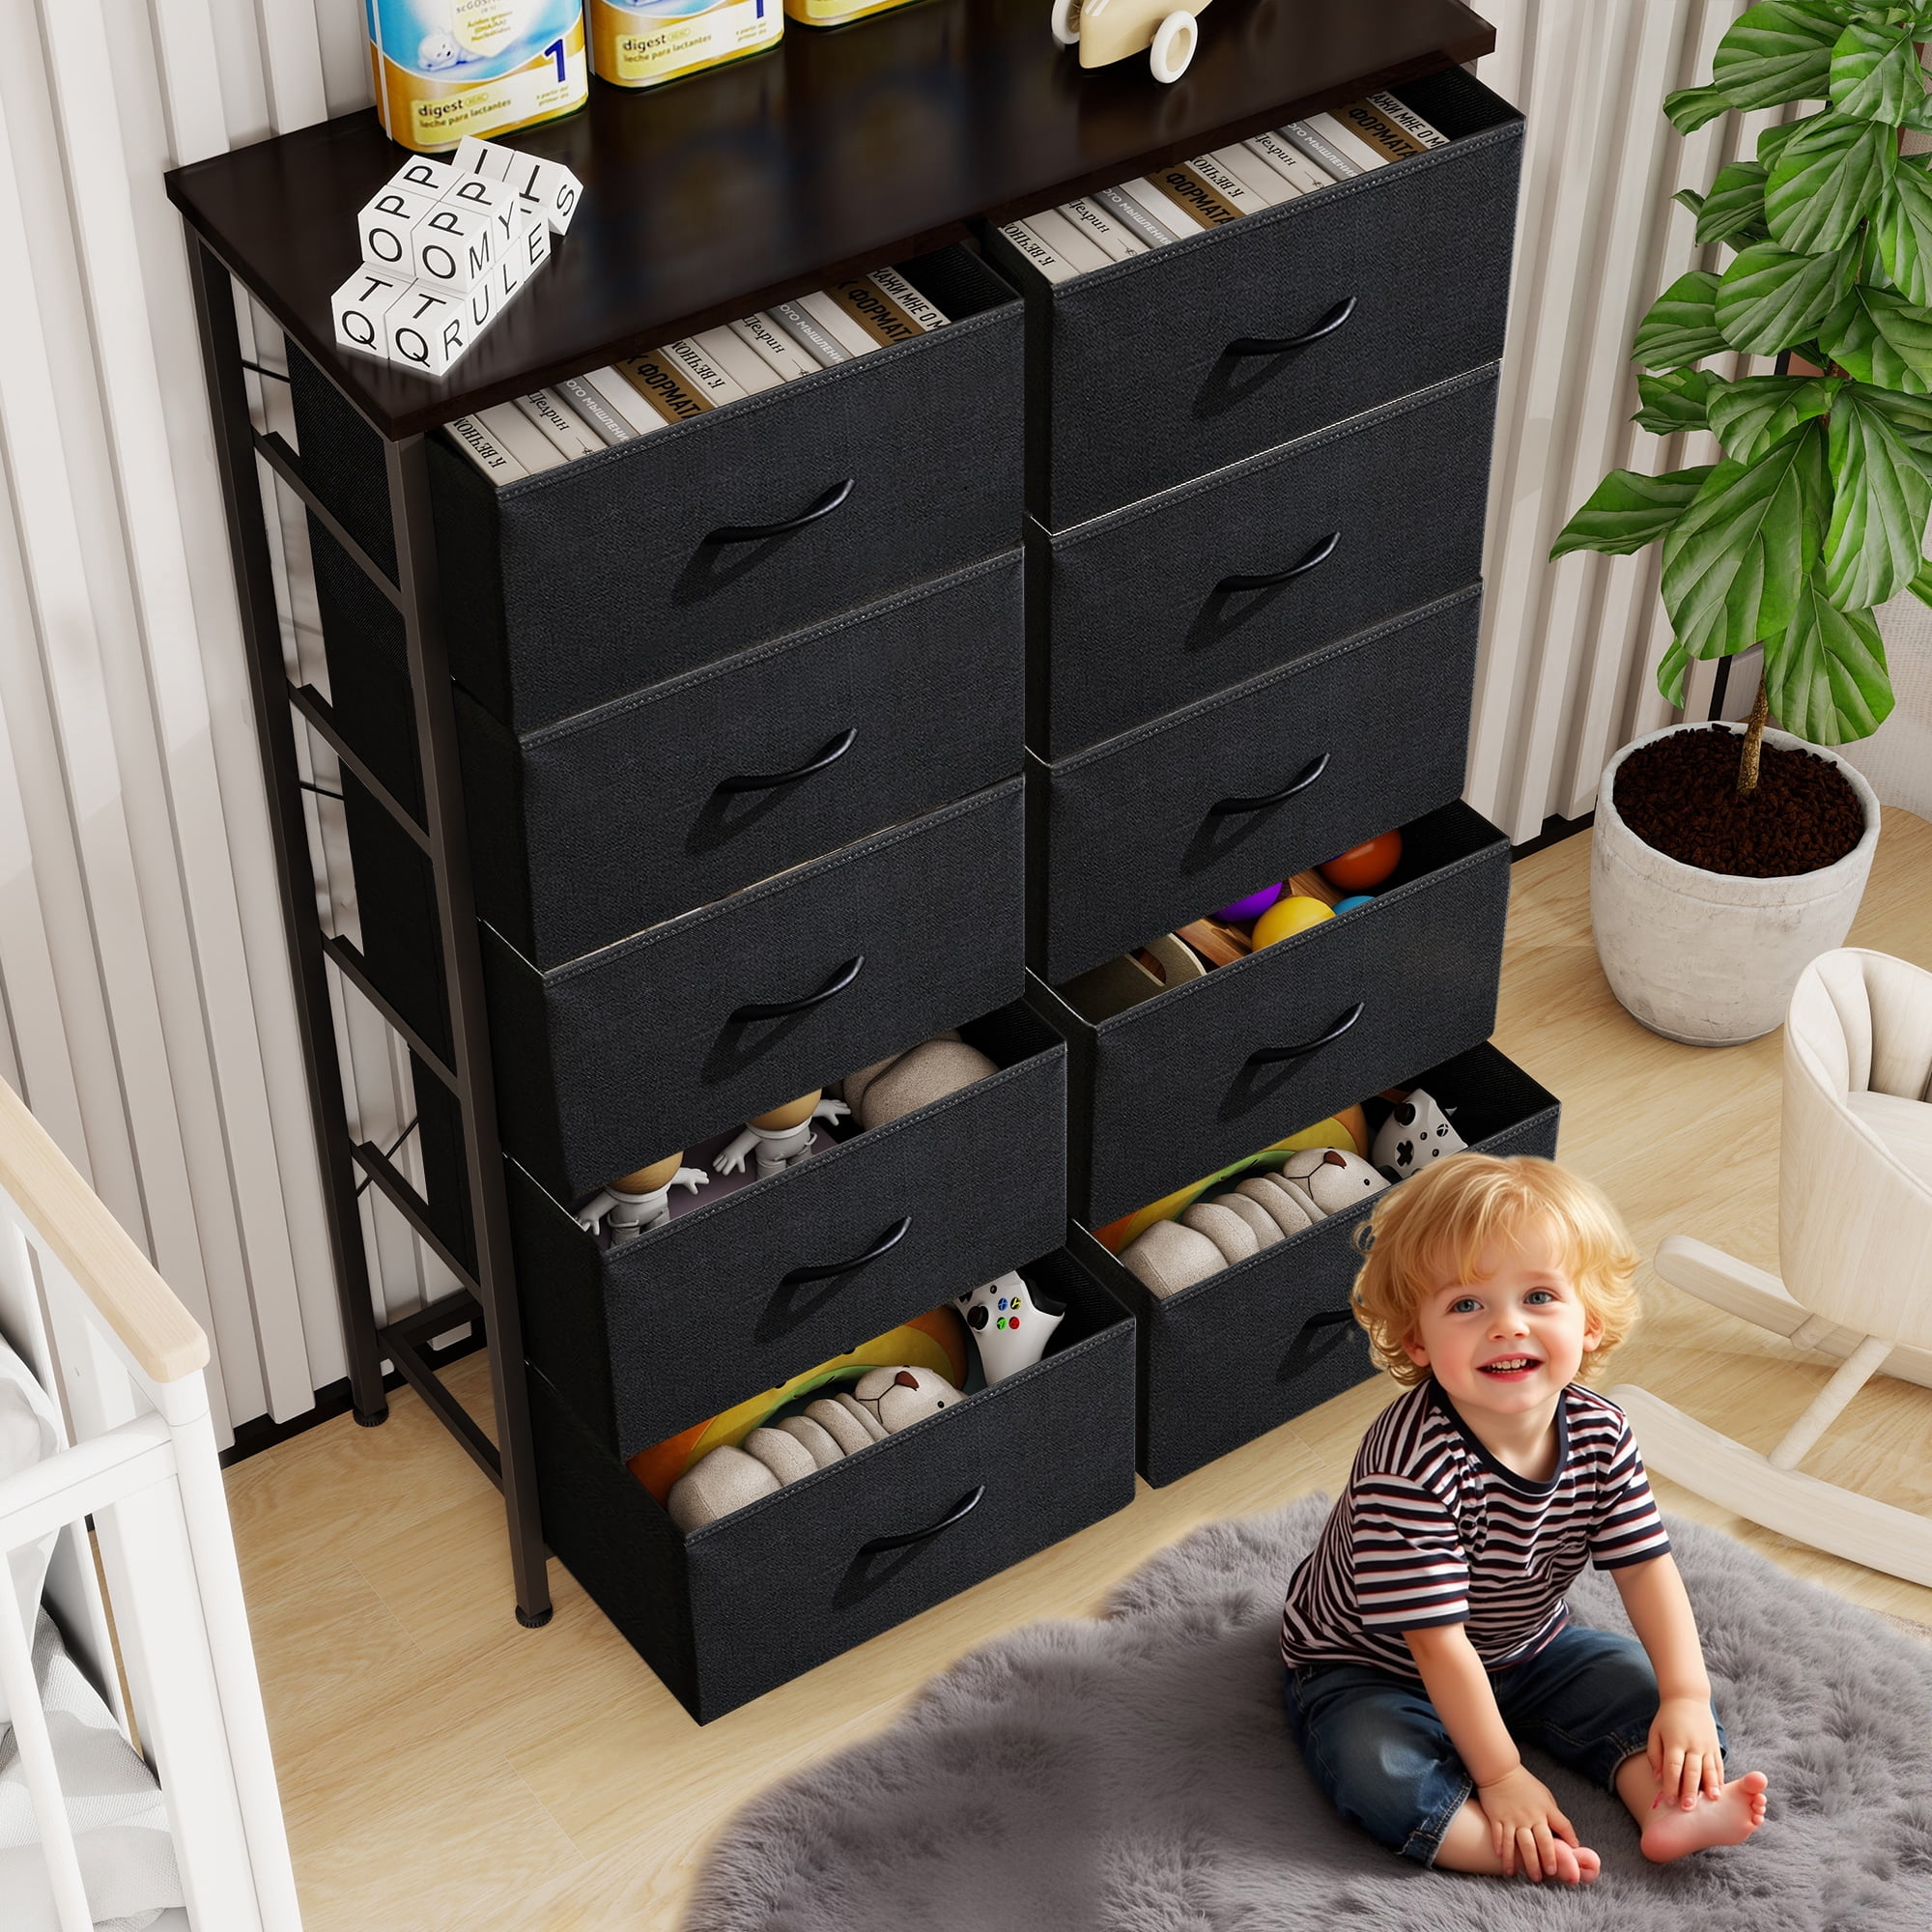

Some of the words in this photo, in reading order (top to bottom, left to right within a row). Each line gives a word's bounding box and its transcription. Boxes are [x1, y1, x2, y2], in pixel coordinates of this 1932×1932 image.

[623, 35, 666, 53] digest
[544, 39, 566, 83] 1
[418, 99, 463, 119] digest
[1399, 112, 1426, 133] МНЕ
[1192, 156, 1235, 190] ВЕЧНО
[899, 293, 928, 316] МНЕ
